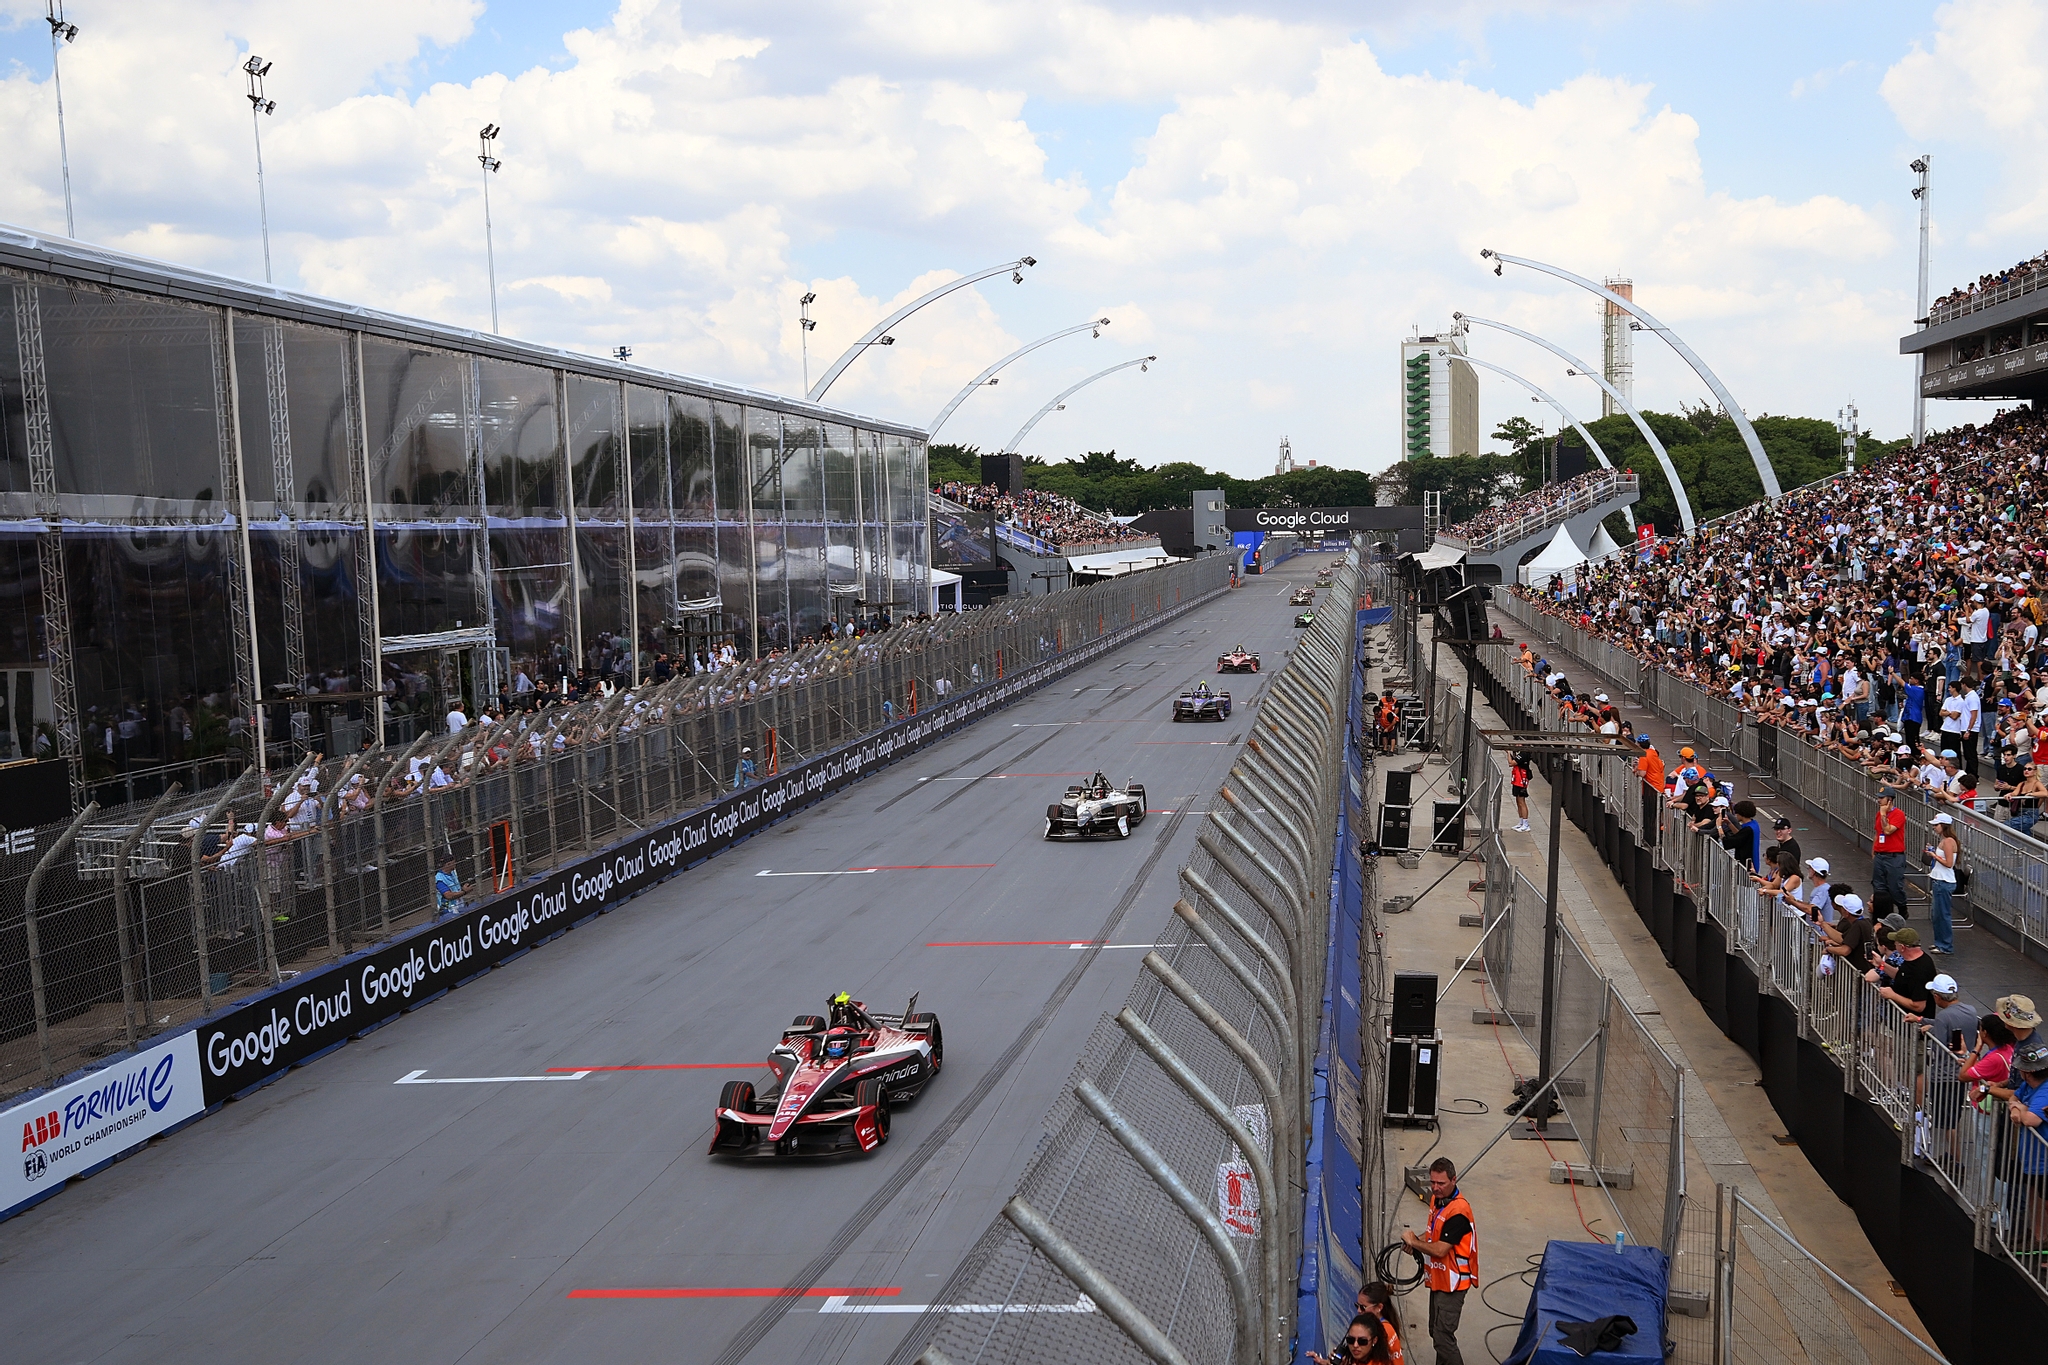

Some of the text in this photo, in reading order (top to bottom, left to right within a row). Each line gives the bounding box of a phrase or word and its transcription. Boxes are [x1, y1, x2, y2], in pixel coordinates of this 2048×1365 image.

[1256, 510, 1349, 529] Google Cloud
[876, 728, 906, 759] Google Cloud
[906, 717, 932, 745] Google Cloud
[806, 757, 842, 792] Google Cloud
[843, 742, 876, 774] Google Cloud
[761, 774, 804, 813] Google Cloud
[710, 794, 760, 838] Google Cloud
[648, 819, 707, 867] Google Cloud
[572, 848, 645, 904] Google Cloud
[478, 882, 567, 950] Google Cloud
[361, 925, 473, 1005] Google Cloud
[207, 979, 352, 1077] Google Cloud
[871, 1063, 920, 1083] hindra
[22, 1110, 61, 1153] ABB
[63, 1066, 147, 1138] FORMULA
[785, 1094, 807, 1102] 21
[49, 1108, 147, 1163] WORLD CHAMPIONSHIP
